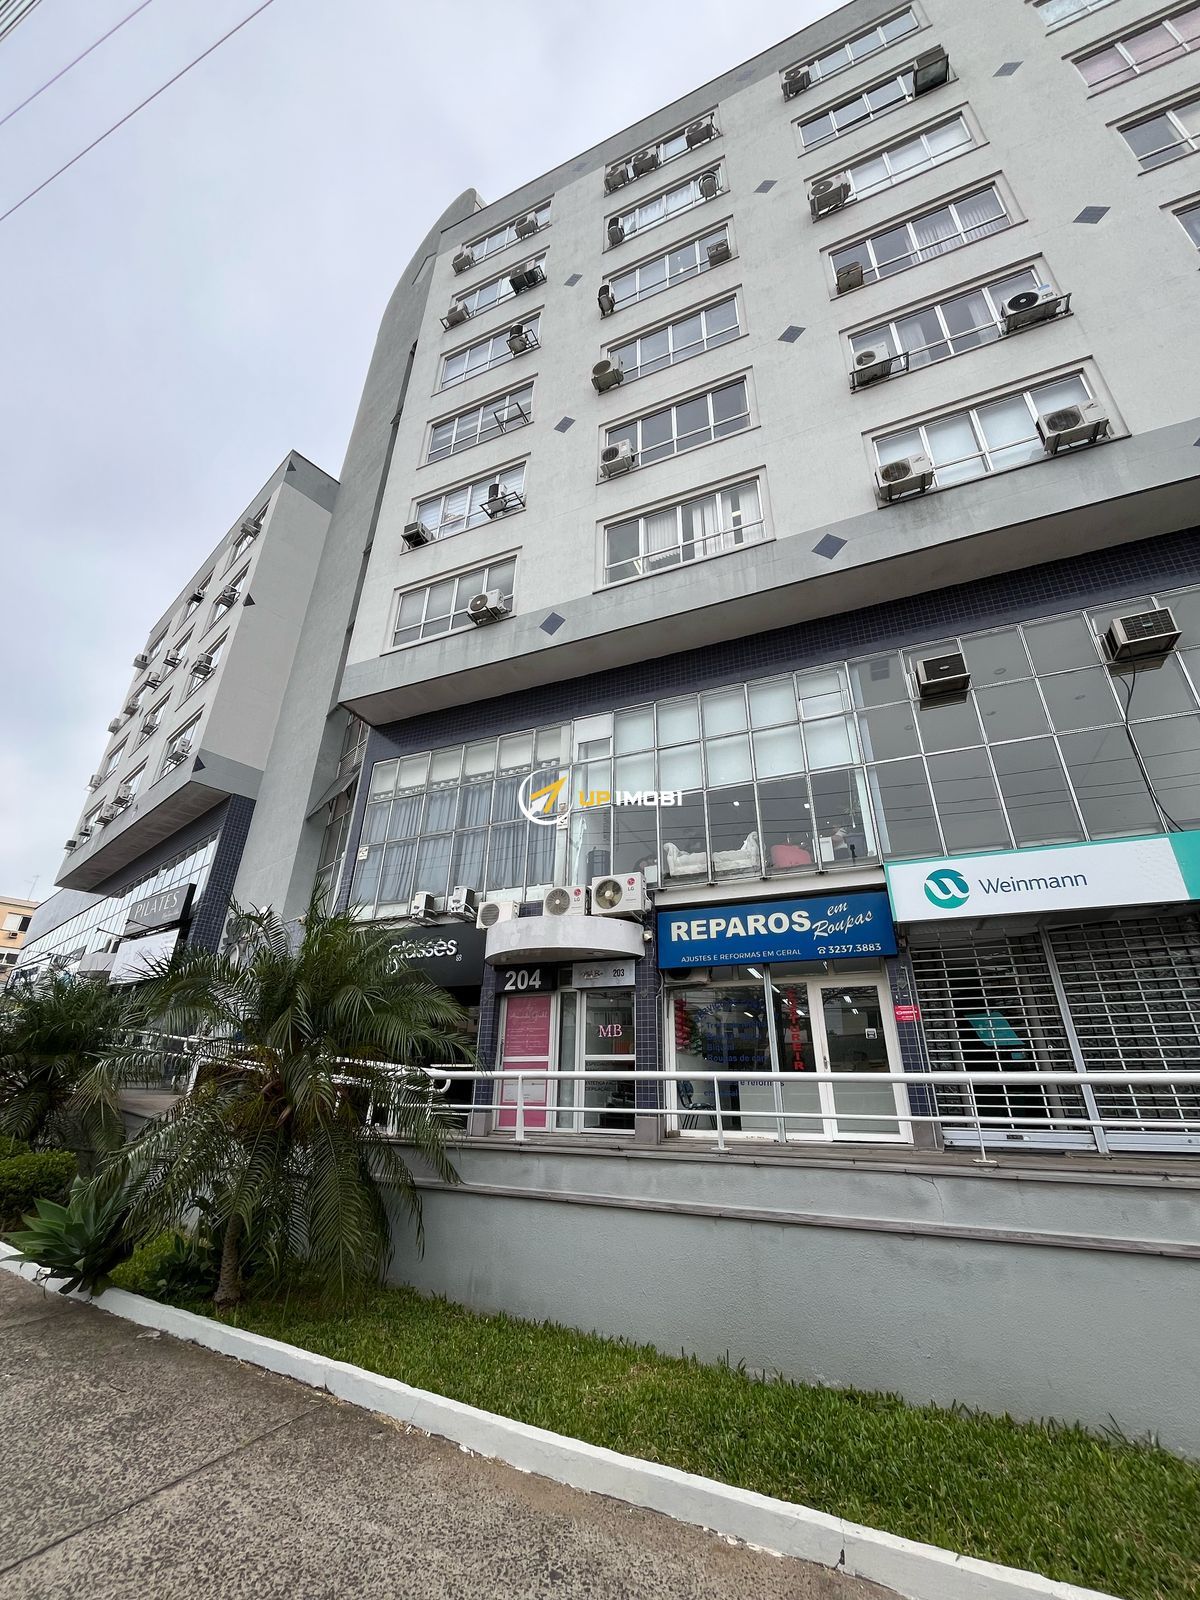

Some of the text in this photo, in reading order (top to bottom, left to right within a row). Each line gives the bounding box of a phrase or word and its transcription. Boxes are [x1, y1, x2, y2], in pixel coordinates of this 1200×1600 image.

[978, 871, 1088, 895] Weinmann
[134, 890, 181, 920] PILATES
[671, 910, 812, 942] REPAROS
[812, 902, 873, 941] em Roupas
[681, 955, 711, 963] AJUSTES
[719, 951, 761, 961] REFORMAS
[762, 950, 775, 958] EM
[776, 949, 802, 957] GERAL
[828, 943, 881, 954] 3237.3883
[504, 969, 541, 991] 204
[612, 968, 625, 977] 203
[598, 1023, 623, 1038] MB
